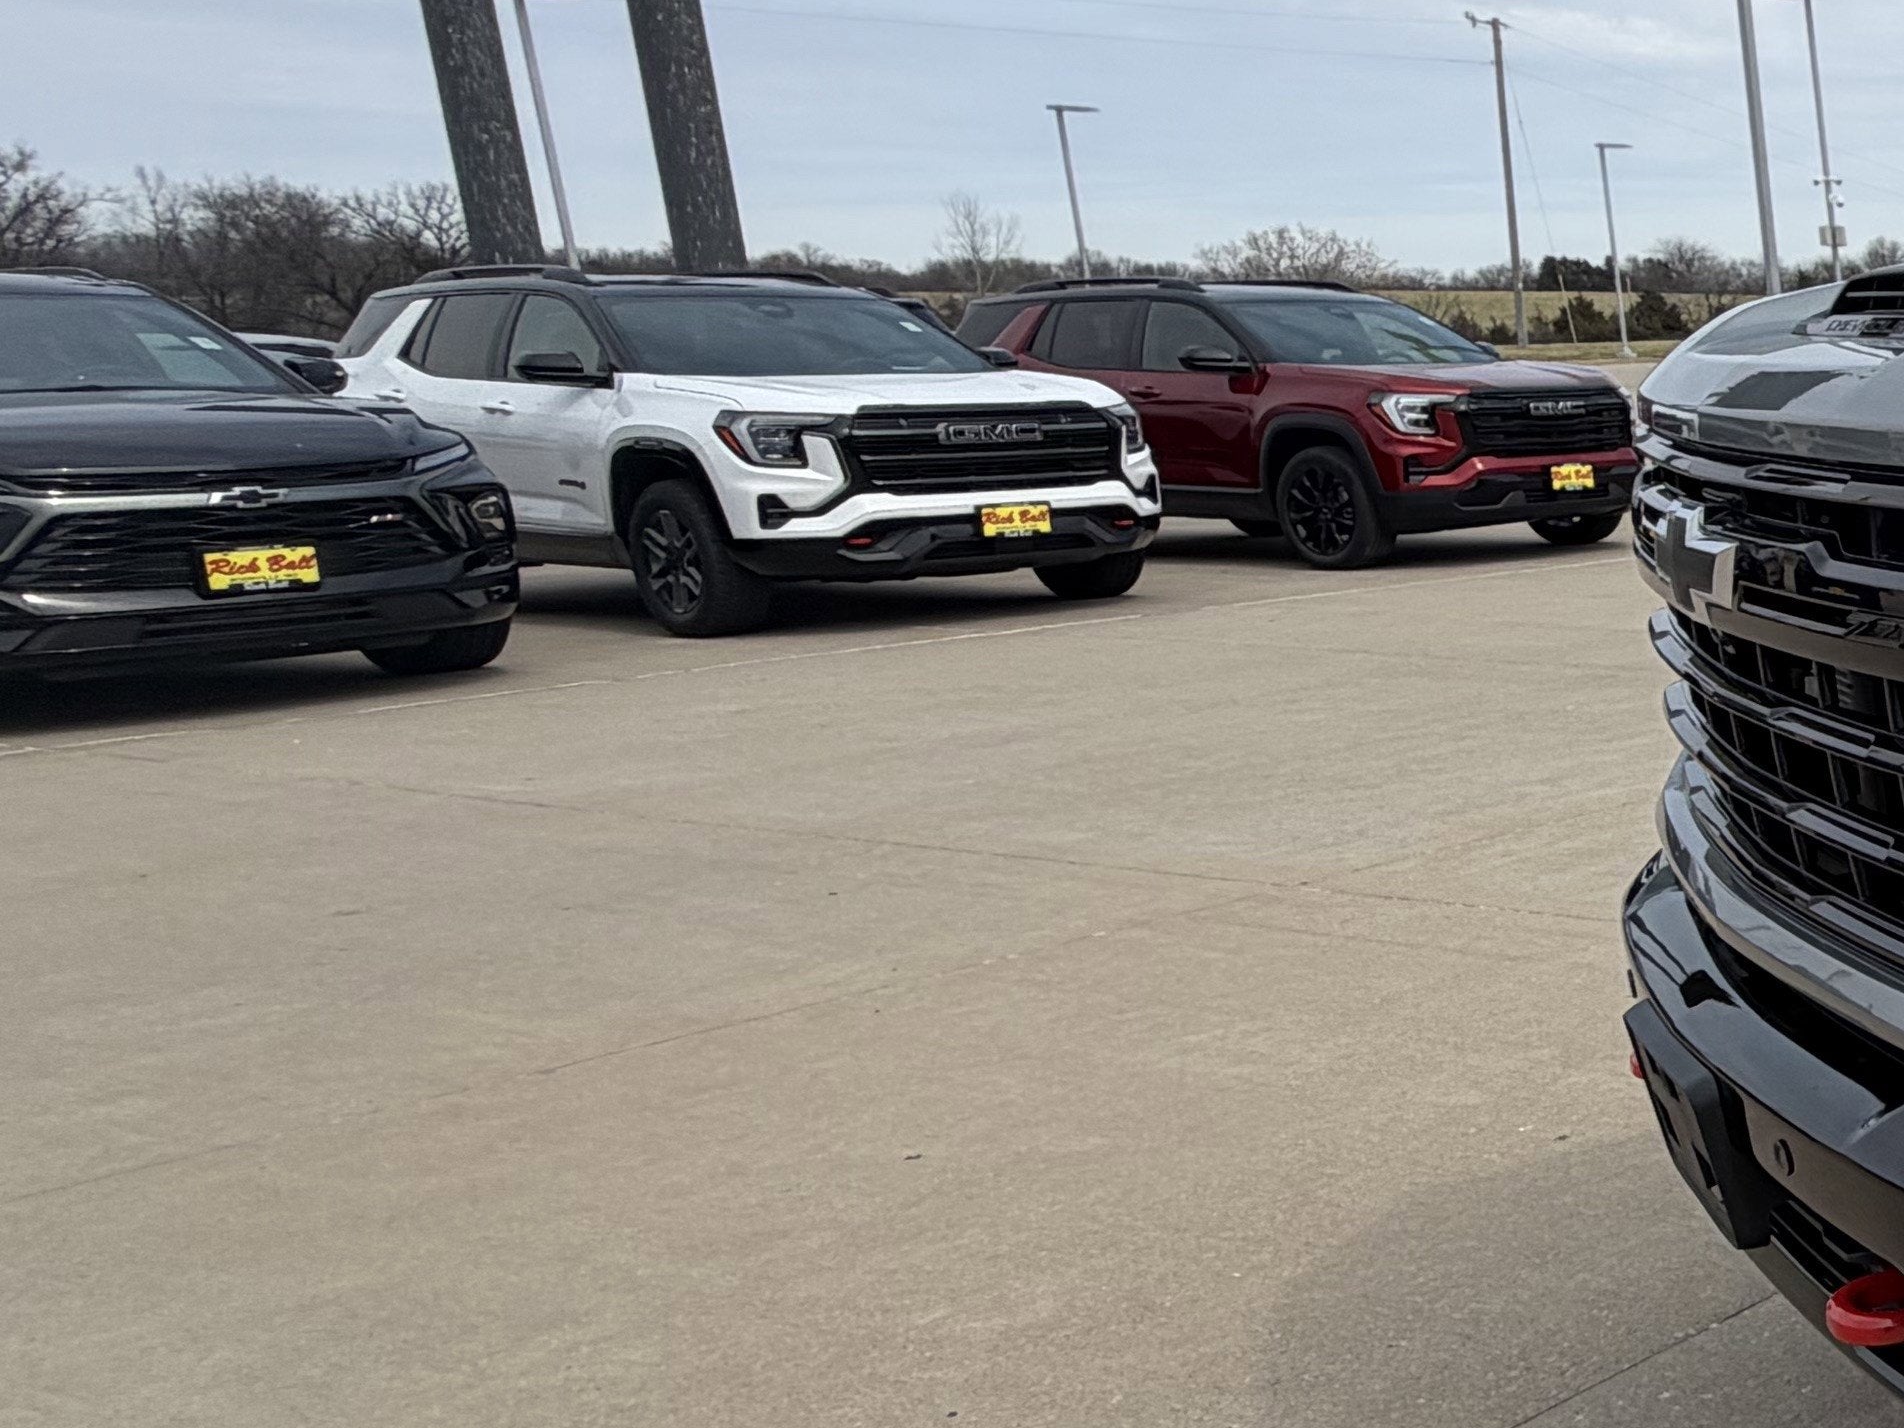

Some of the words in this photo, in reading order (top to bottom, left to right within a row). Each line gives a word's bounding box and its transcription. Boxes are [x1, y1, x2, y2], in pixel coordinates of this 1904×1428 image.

[948, 422, 1044, 444] GMC
[206, 558, 261, 578] Rick
[266, 554, 316, 573] Ball
